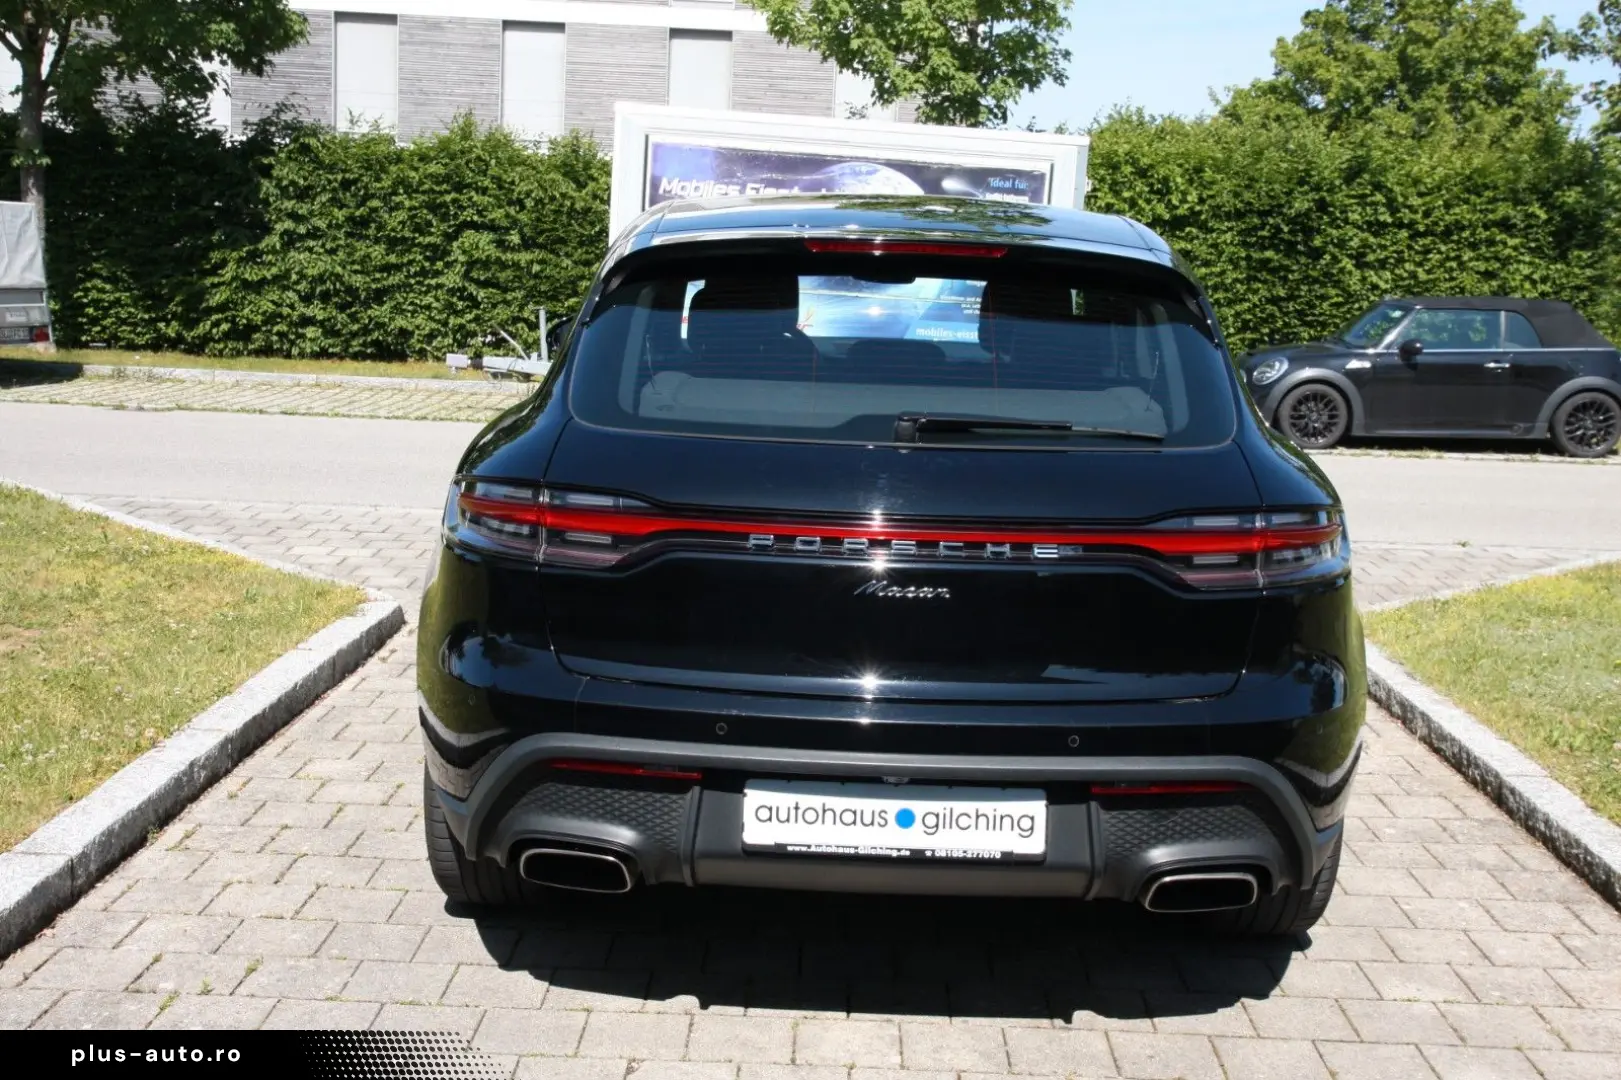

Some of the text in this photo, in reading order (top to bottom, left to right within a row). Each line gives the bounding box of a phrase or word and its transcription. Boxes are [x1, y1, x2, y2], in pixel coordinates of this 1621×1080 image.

[658, 177, 740, 199] Mobiles
[990, 178, 1012, 188] Ideal
[748, 533, 1059, 559] PORSCHE
[854, 580, 950, 599] Macan
[754, 801, 1036, 839] autohaus gilching
